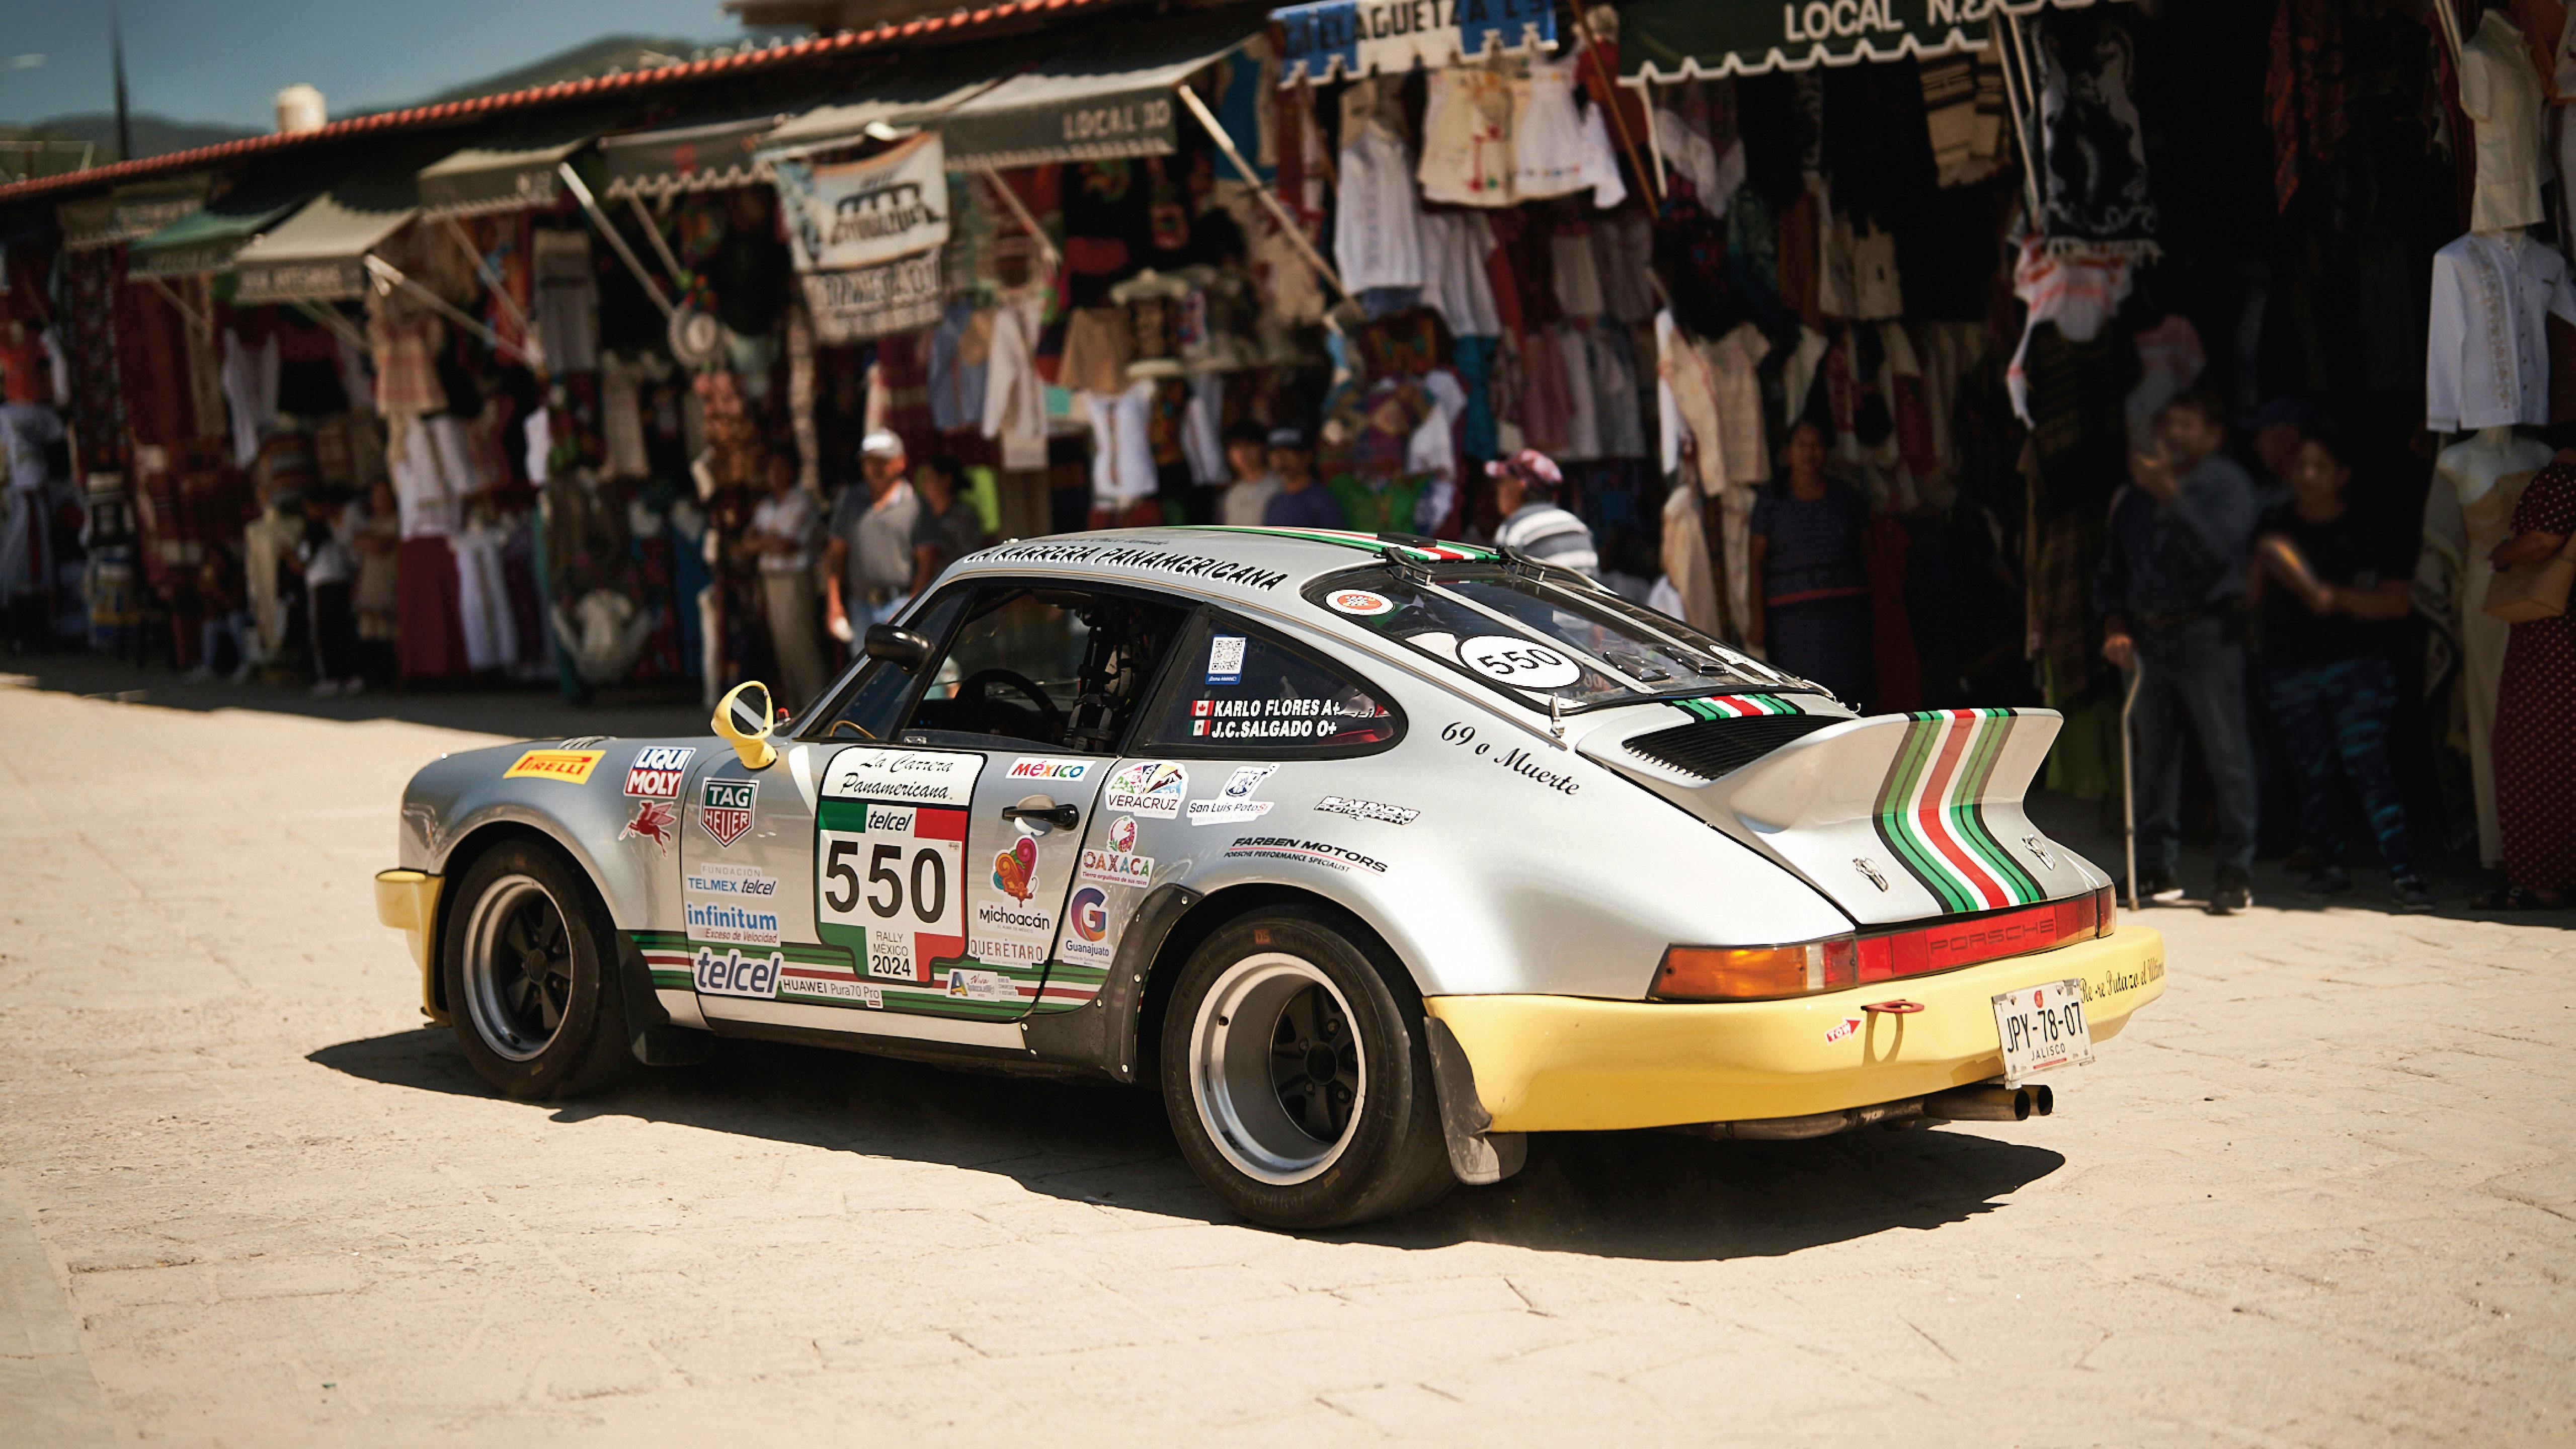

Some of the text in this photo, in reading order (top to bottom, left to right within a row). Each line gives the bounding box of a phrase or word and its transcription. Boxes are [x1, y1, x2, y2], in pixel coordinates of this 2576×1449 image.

[1784, 0, 1904, 41] LOCAL
[1063, 105, 1136, 141] LOCAL
[990, 546, 1101, 564] KARRERA
[1090, 548, 1289, 593] PANAMERICANA
[1477, 649, 1562, 675] 550
[1213, 700, 1261, 717] KARLO
[1265, 699, 1321, 717] FLORES
[1320, 699, 1341, 717] A+
[1212, 720, 1337, 738] J.C.SALGADO O+
[516, 756, 592, 775] PIRELLI
[636, 749, 690, 770] LIQUI
[859, 751, 954, 773] La Carrera
[1441, 721, 1580, 795] 69 o Muerte
[627, 772, 682, 795] MOLY
[709, 786, 750, 807] TAG
[1109, 794, 1178, 811] VERACRUZ
[1189, 802, 1210, 814] San
[1210, 802, 1233, 813] Luis
[704, 811, 749, 840] HEUER
[868, 810, 914, 831] telcel
[1083, 851, 1150, 876] OAXACA
[1232, 837, 1388, 873] FARBEN MOTORS
[1254, 851, 1308, 862] PERFORMANCE
[1308, 856, 1351, 873] SPECIALIST
[688, 877, 778, 896] TELMEX telcel
[825, 840, 946, 923] 550
[687, 904, 777, 931] infinitum
[979, 905, 1050, 930] Michoacán
[705, 929, 778, 944] Exceso de Velocidad
[876, 931, 904, 943] RALLY
[1929, 918, 2054, 954] PORSCHE
[873, 942, 909, 956] MÉXICO
[970, 938, 1043, 961] QUERÉTARO
[1066, 940, 1109, 956] Guanajuato
[697, 952, 780, 994] telcel
[872, 955, 911, 977] 2024
[783, 979, 880, 999] HUAWEI Pura70 Pro
[1826, 1022, 1852, 1039] TOW
[2006, 1001, 2083, 1053] JPY-78-07
[2031, 1042, 2065, 1061] JALISCO
